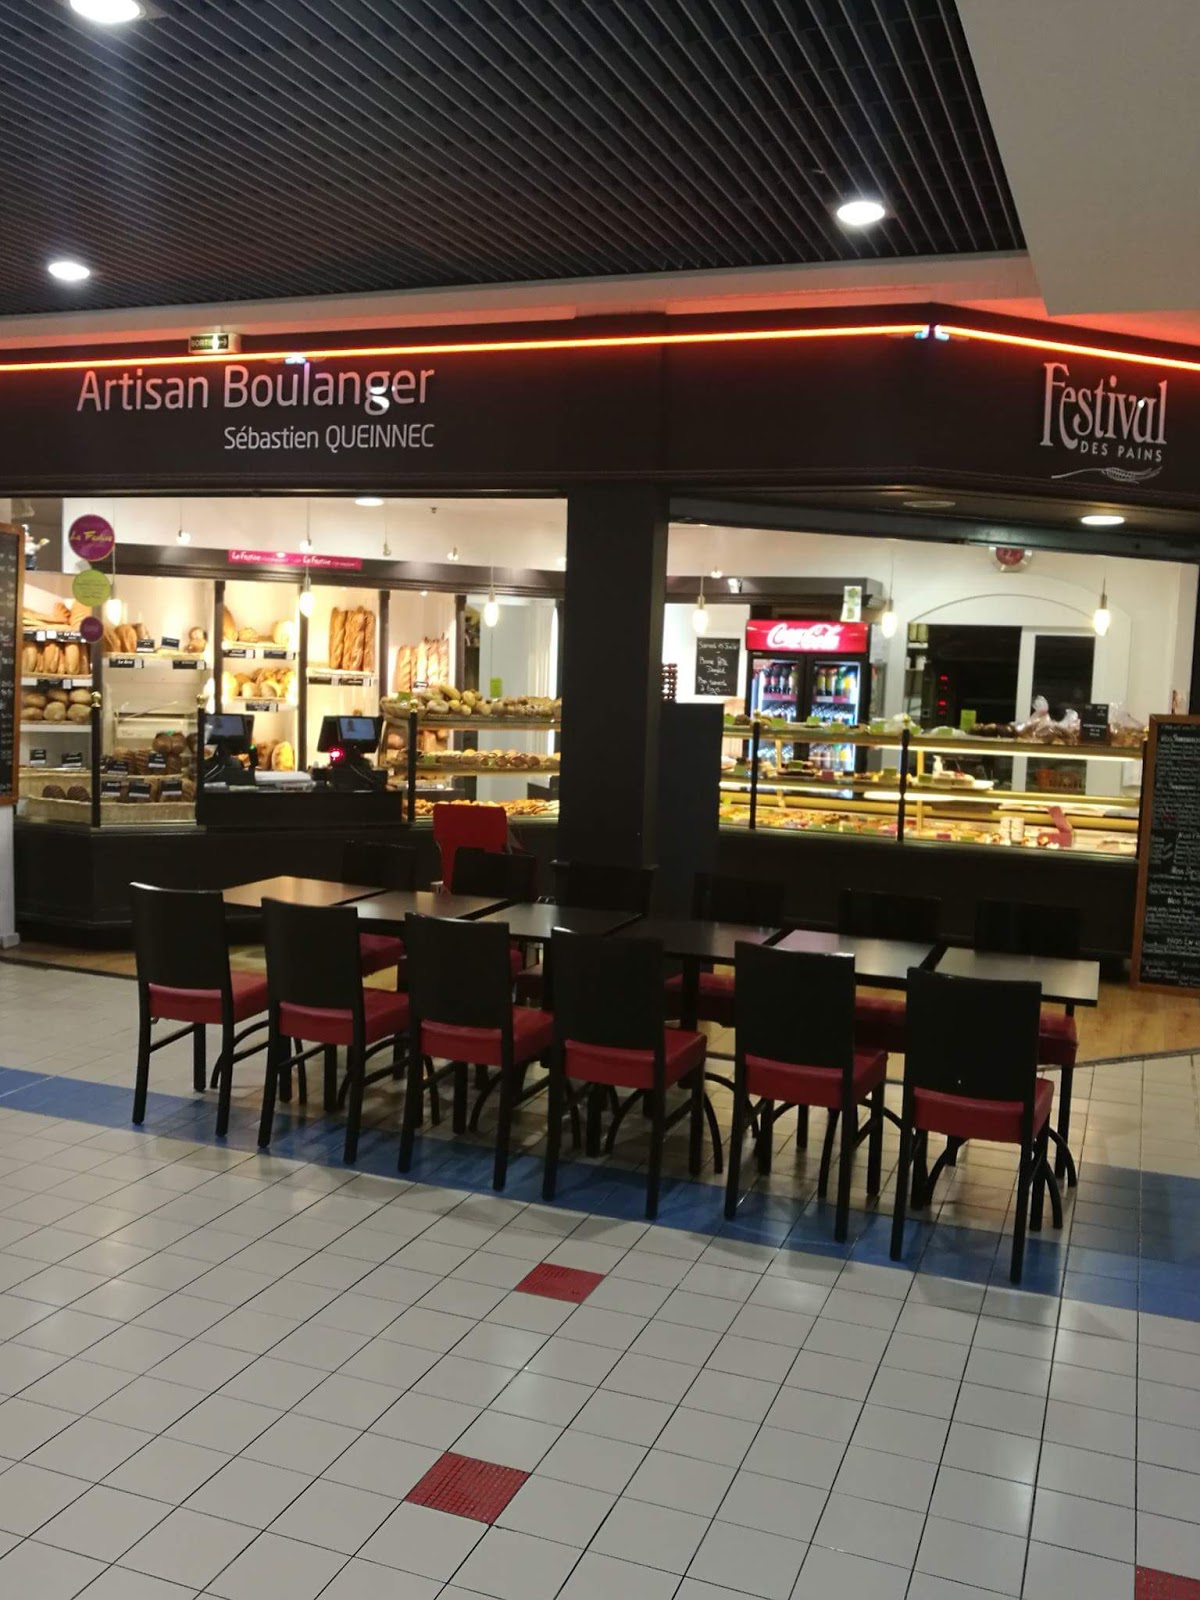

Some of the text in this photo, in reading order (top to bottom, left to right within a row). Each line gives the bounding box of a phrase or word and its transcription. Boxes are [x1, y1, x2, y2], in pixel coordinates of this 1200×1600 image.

[76, 361, 436, 417] Artisan Boulanger
[1040, 362, 1168, 450] Festival
[223, 423, 436, 453] Sébastien QUEINNEC
[1080, 440, 1163, 462] DES PAINS
